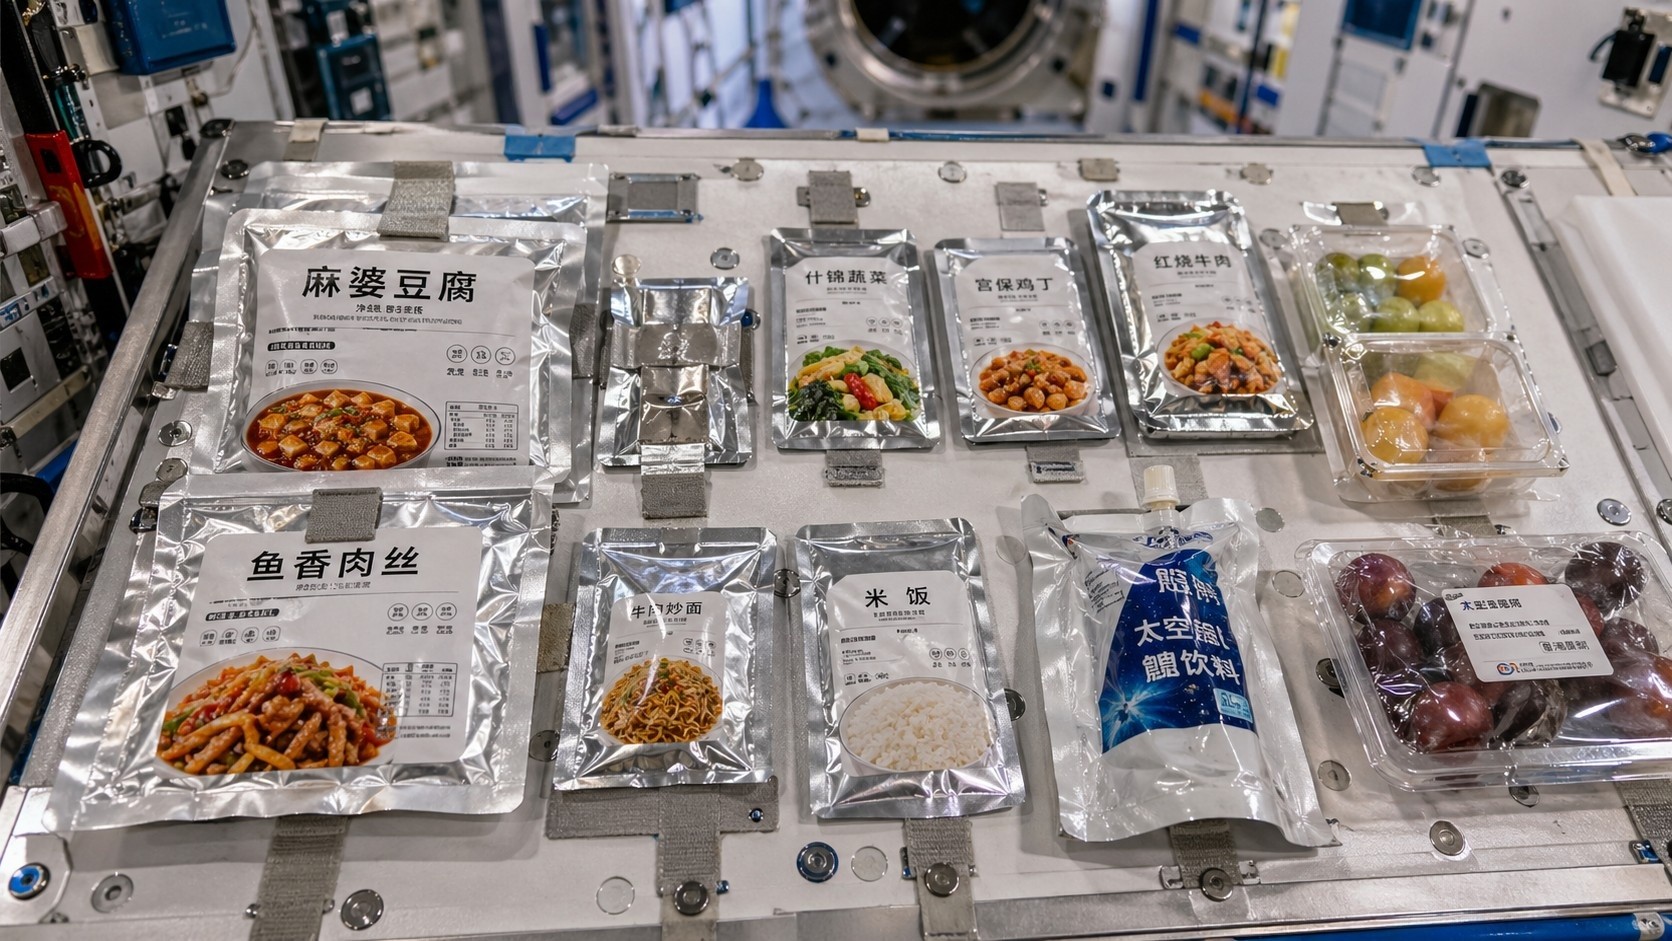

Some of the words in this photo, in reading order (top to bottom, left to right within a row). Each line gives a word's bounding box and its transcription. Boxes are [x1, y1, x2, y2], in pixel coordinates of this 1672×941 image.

[1153, 253, 1232, 269] 红烧牛肉
[302, 265, 477, 303] 麻婆豆腐
[805, 269, 888, 285] 什锦蔬菜
[975, 277, 1053, 292] 宫保鸡丁
[247, 546, 419, 581] 鱼香肉丝
[865, 586, 931, 608] 米饭
